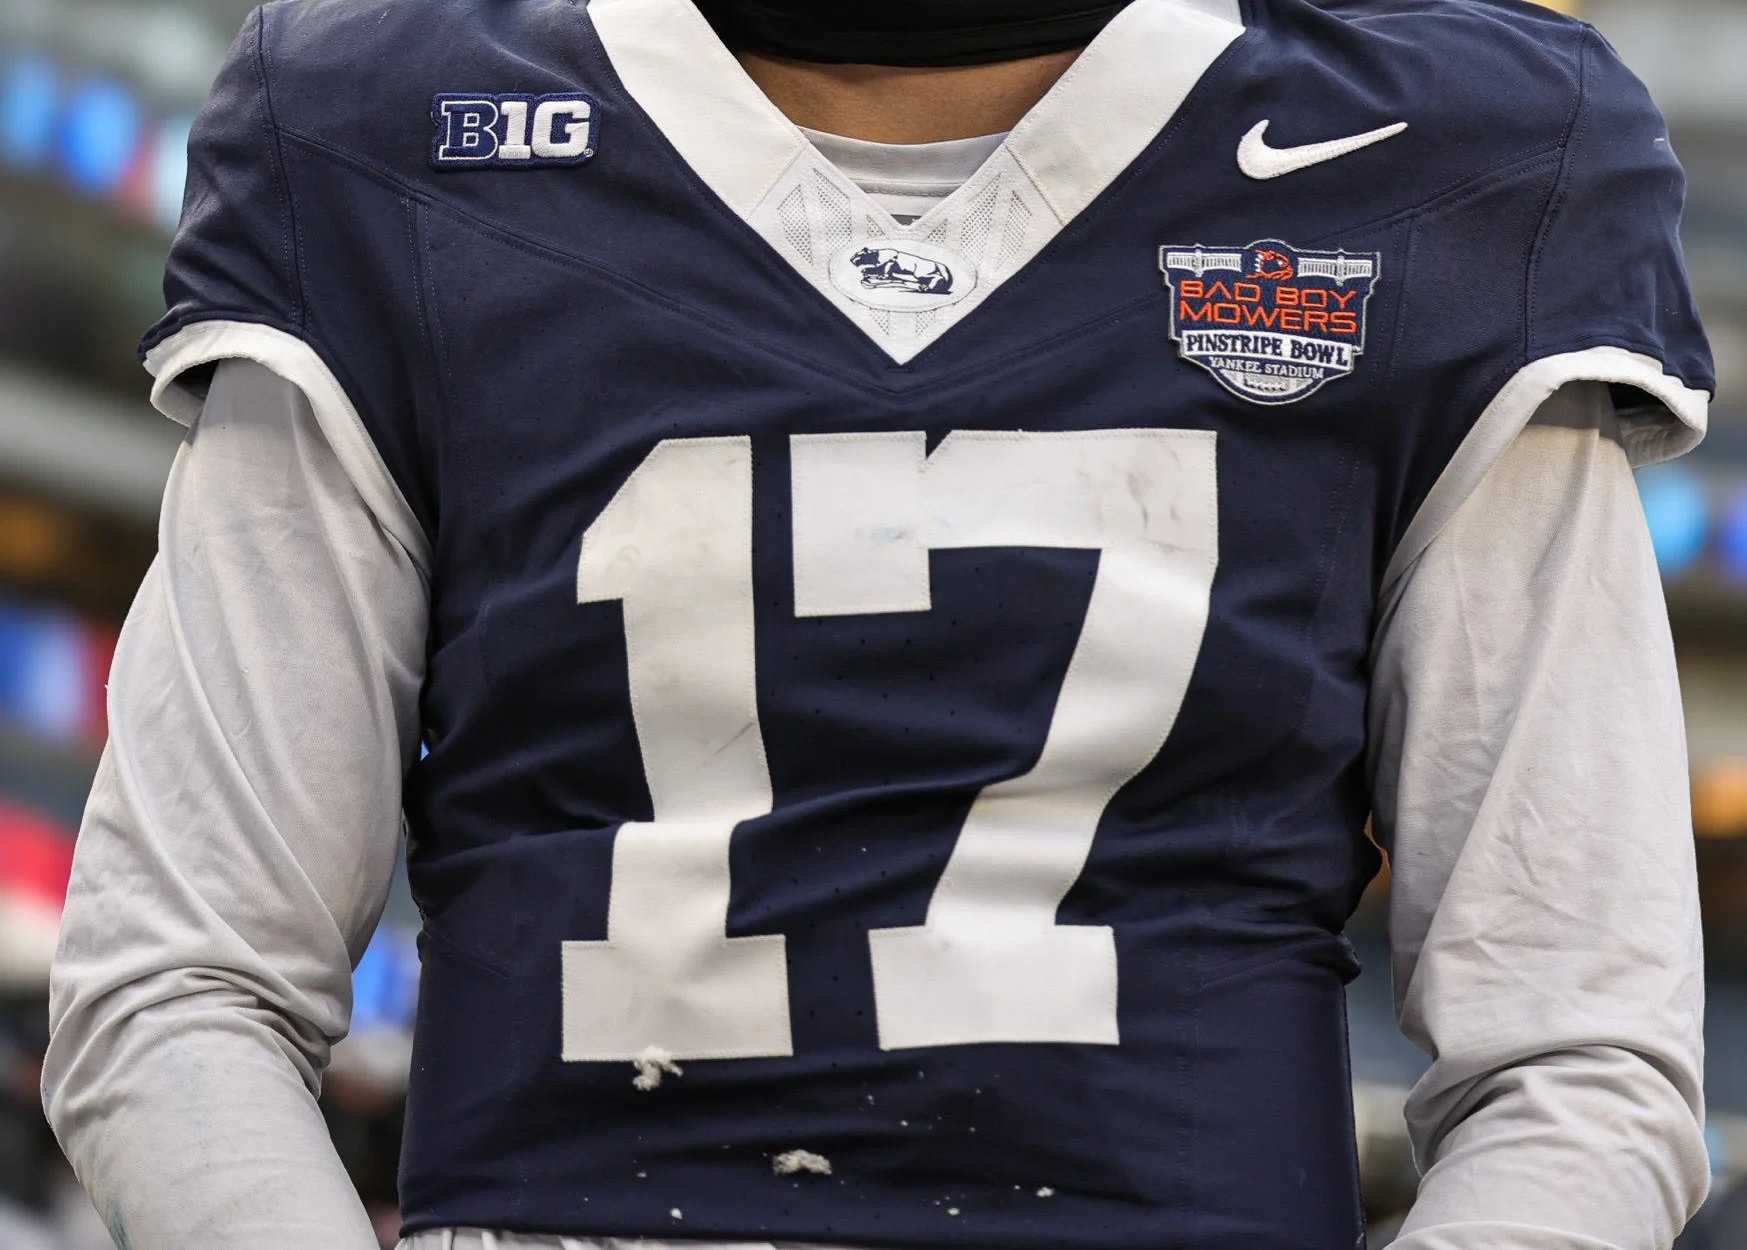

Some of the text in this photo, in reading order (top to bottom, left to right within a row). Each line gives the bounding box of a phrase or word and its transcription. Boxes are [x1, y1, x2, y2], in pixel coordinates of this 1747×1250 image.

[1180, 280, 1357, 308] BAD BOY
[1179, 300, 1357, 333] MOWERS
[1187, 333, 1349, 366] PINSTRIPE BOWL
[1209, 357, 1324, 379] YANKEE STADIUM
[561, 427, 1219, 1062] 17
